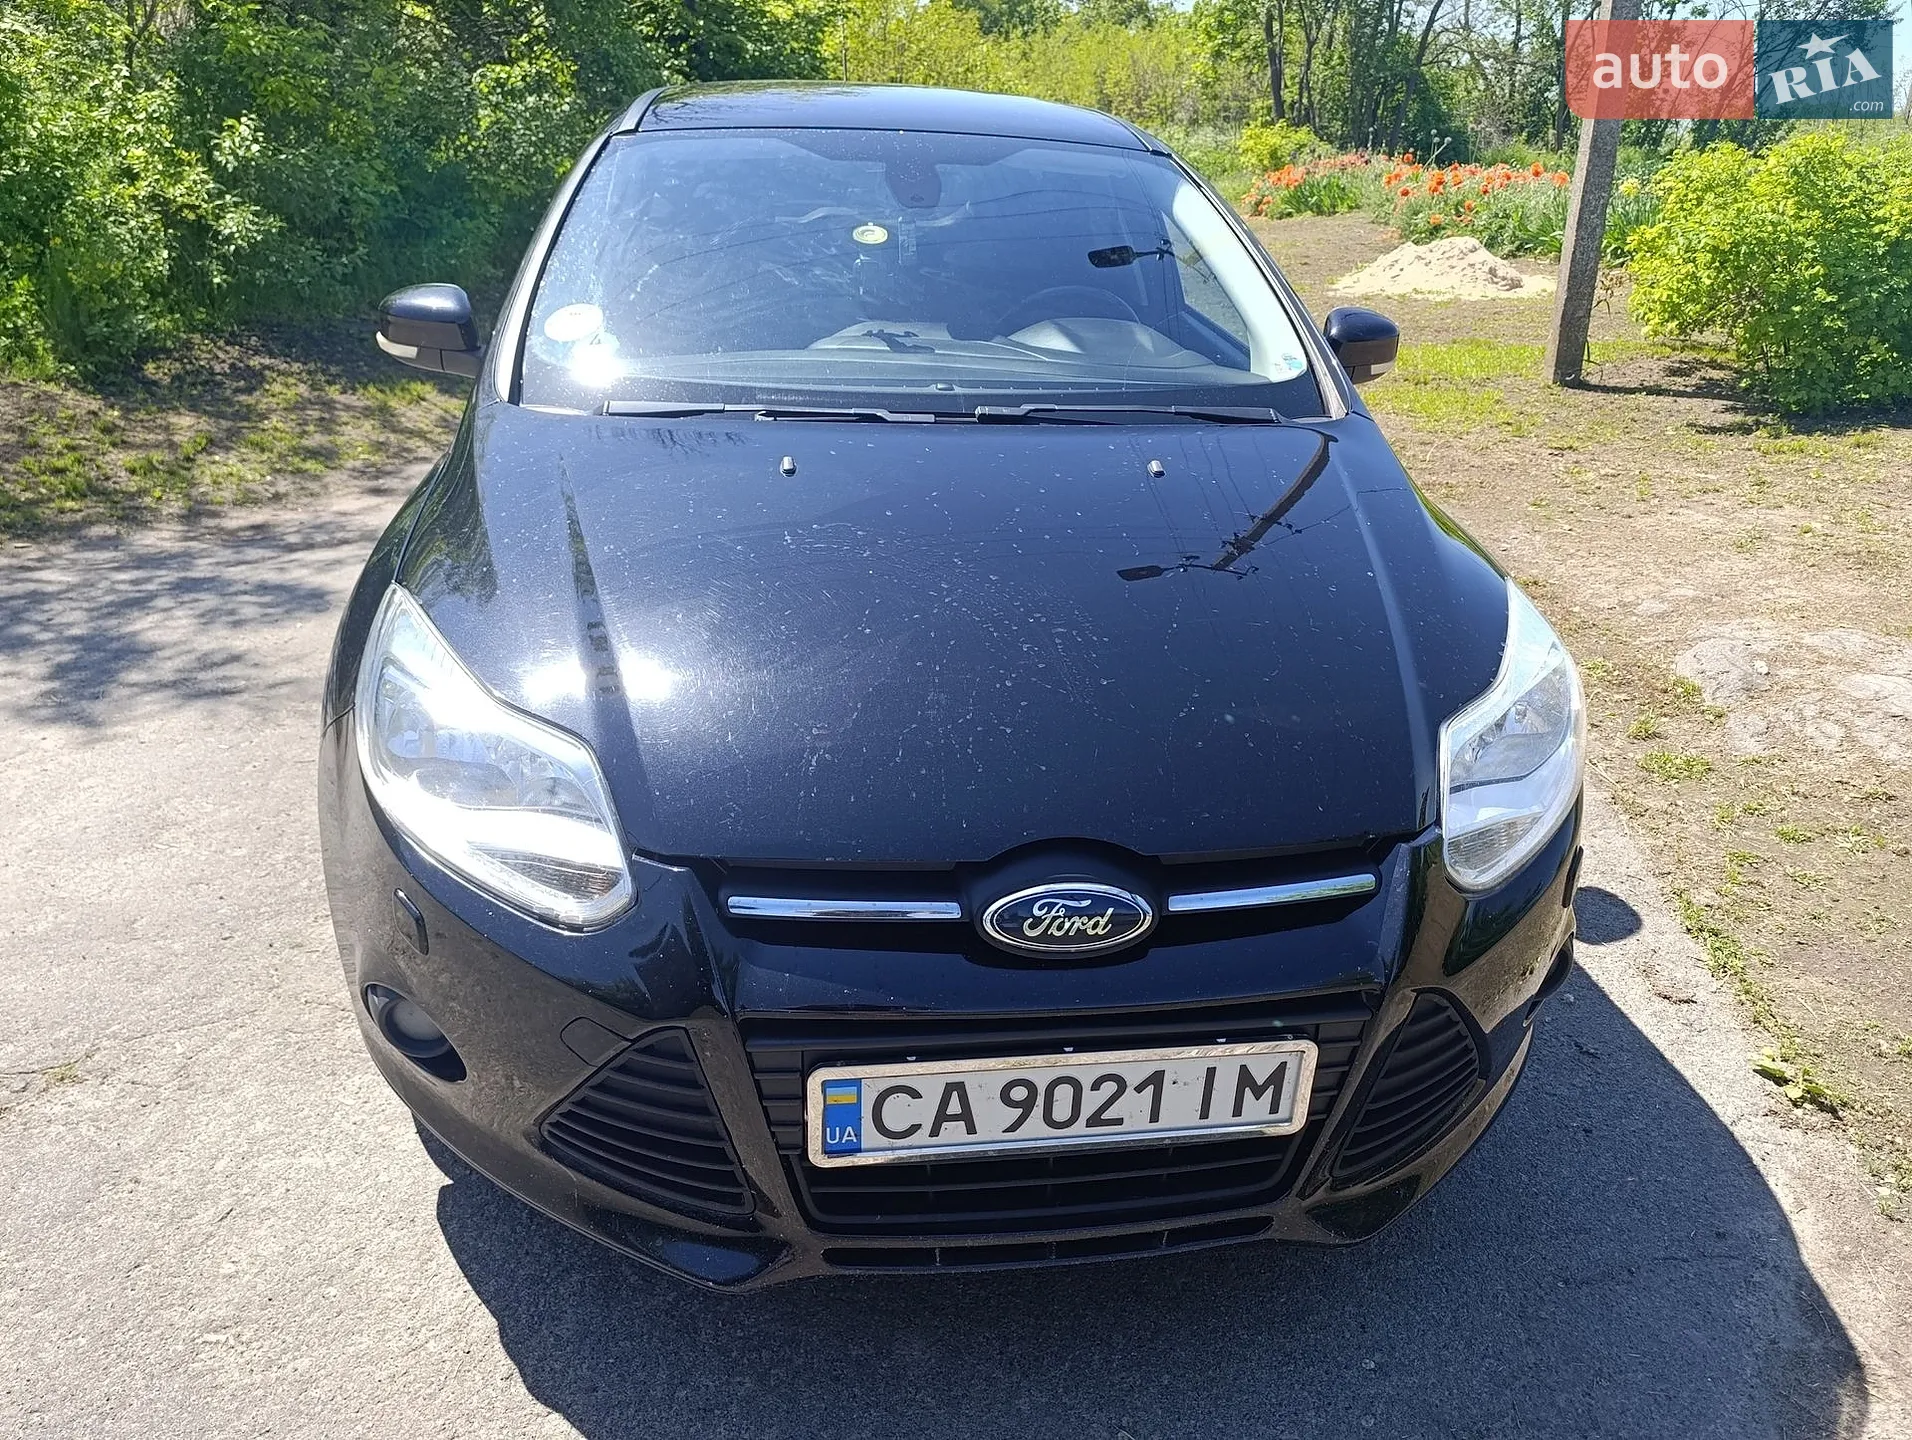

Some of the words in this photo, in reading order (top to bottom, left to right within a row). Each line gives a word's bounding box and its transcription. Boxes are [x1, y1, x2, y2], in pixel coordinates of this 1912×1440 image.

[1023, 899, 1114, 937] Ford
[871, 1081, 978, 1140] CA
[1000, 1070, 1166, 1134] 9021
[1198, 1061, 1288, 1120] IM
[826, 1127, 857, 1145] UA
